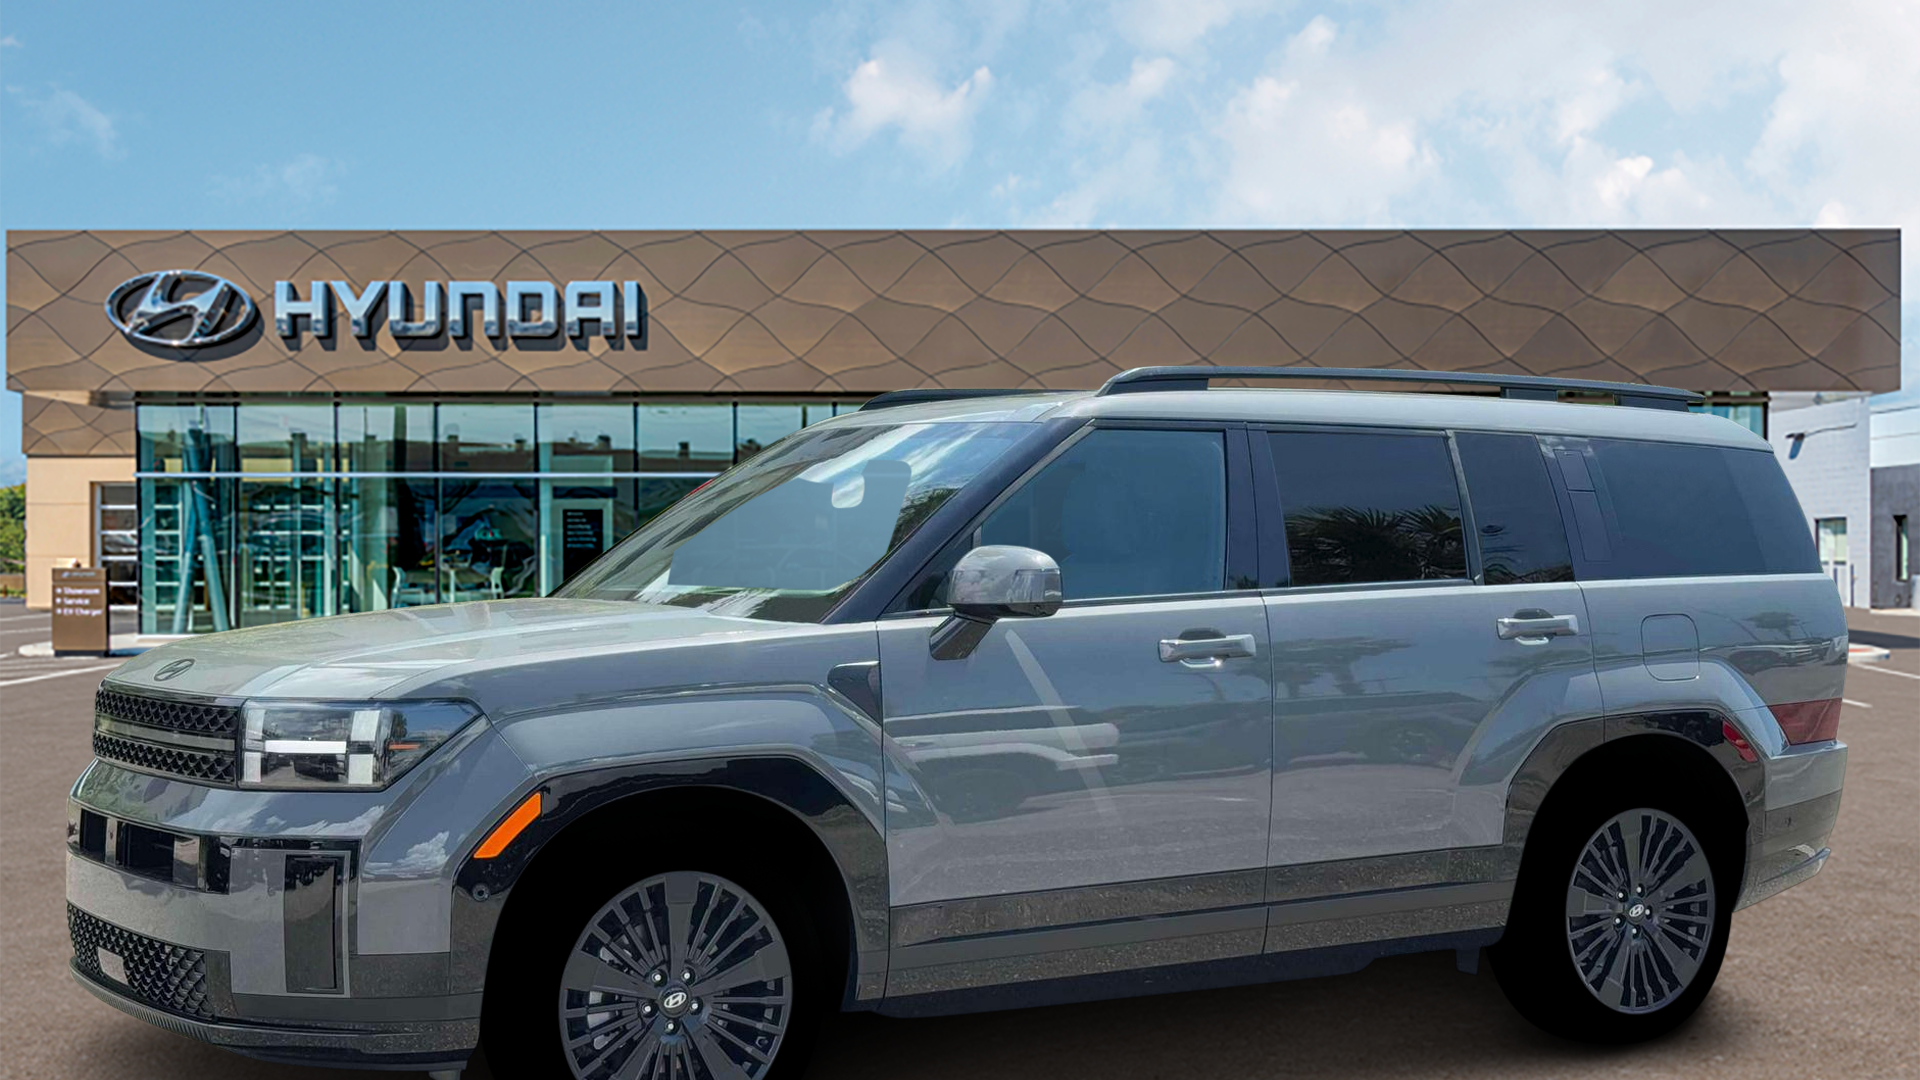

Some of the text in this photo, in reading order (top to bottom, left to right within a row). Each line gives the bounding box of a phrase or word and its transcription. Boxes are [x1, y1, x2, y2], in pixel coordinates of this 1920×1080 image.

[274, 280, 642, 340] HYUNDAI
[63, 587, 100, 595] Showroom
[63, 597, 90, 605] Service
[75, 608, 102, 617] Charger
